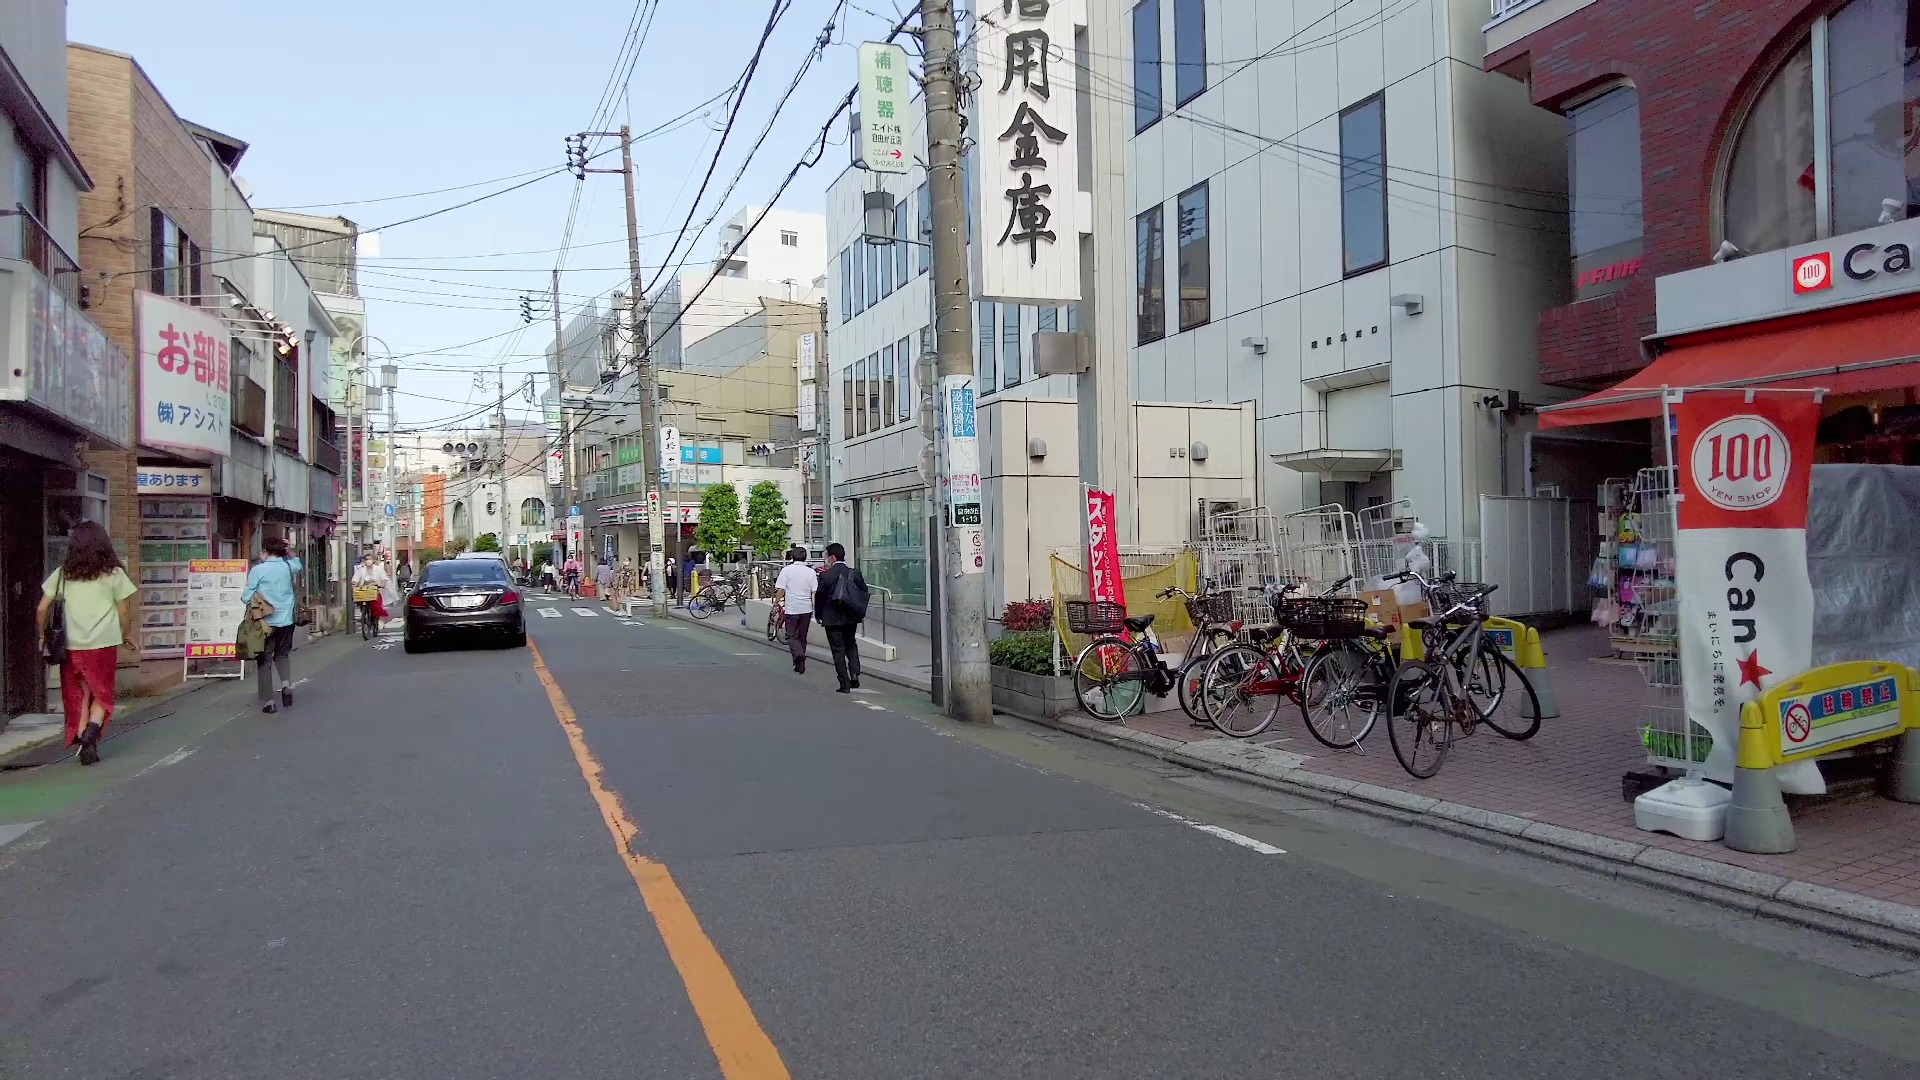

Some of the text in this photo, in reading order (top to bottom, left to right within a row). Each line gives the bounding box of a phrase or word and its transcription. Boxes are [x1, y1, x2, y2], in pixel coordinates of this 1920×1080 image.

[874, 50, 894, 119] 補聴器
[1803, 263, 1820, 280] 100
[157, 322, 228, 394] お部屋
[952, 390, 965, 436] 泌尿器科
[1708, 433, 1772, 482] 100
[1711, 486, 1772, 502] YEN SHOP
[1725, 552, 1765, 643] Can
[1822, 682, 1892, 715] 駐輪禁止
